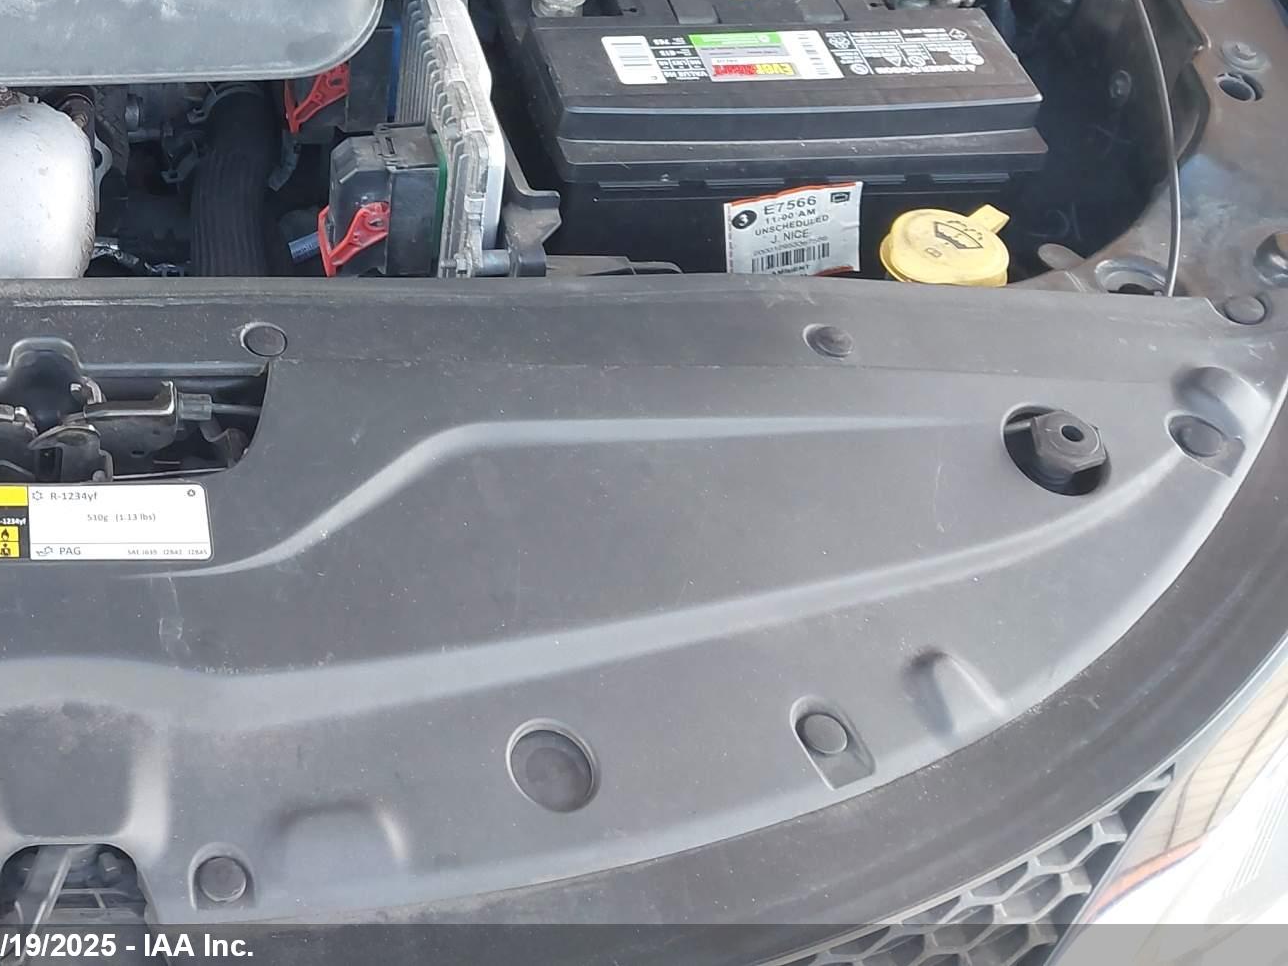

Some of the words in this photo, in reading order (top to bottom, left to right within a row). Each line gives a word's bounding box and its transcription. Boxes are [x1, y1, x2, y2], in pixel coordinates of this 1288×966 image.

[764, 196, 817, 215] E7566
[797, 207, 816, 218] AM
[754, 214, 830, 236] UNSCHEDULED
[782, 228, 809, 242] NICE
[50, 491, 98, 502] R-1234yf
[59, 546, 81, 556] PAG
